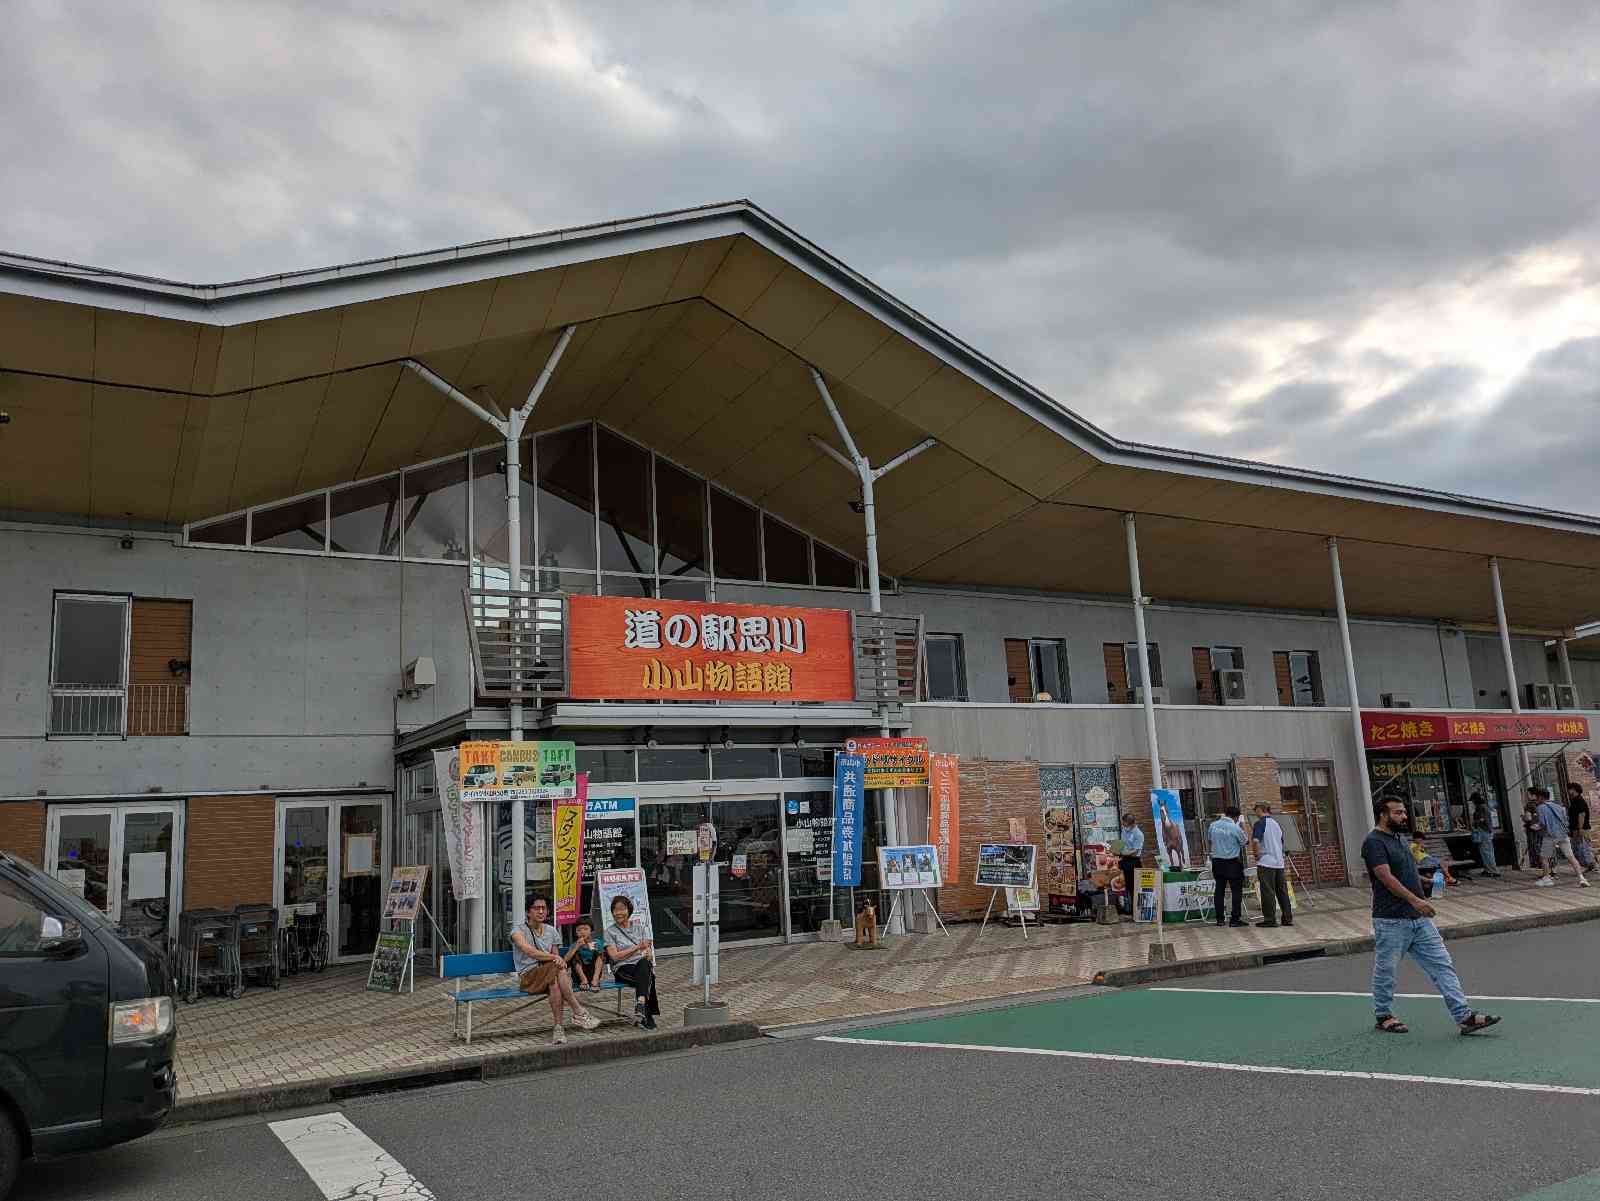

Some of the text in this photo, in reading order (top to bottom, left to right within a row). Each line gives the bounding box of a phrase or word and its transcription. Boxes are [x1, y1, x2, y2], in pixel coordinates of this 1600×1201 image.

[624, 609, 806, 654] 道の駅思川
[643, 658, 793, 692] 小山物語館
[1371, 719, 1435, 740] たこ焼き
[1453, 720, 1487, 736] たこ焼き
[557, 809, 578, 896] スタンプラリー
